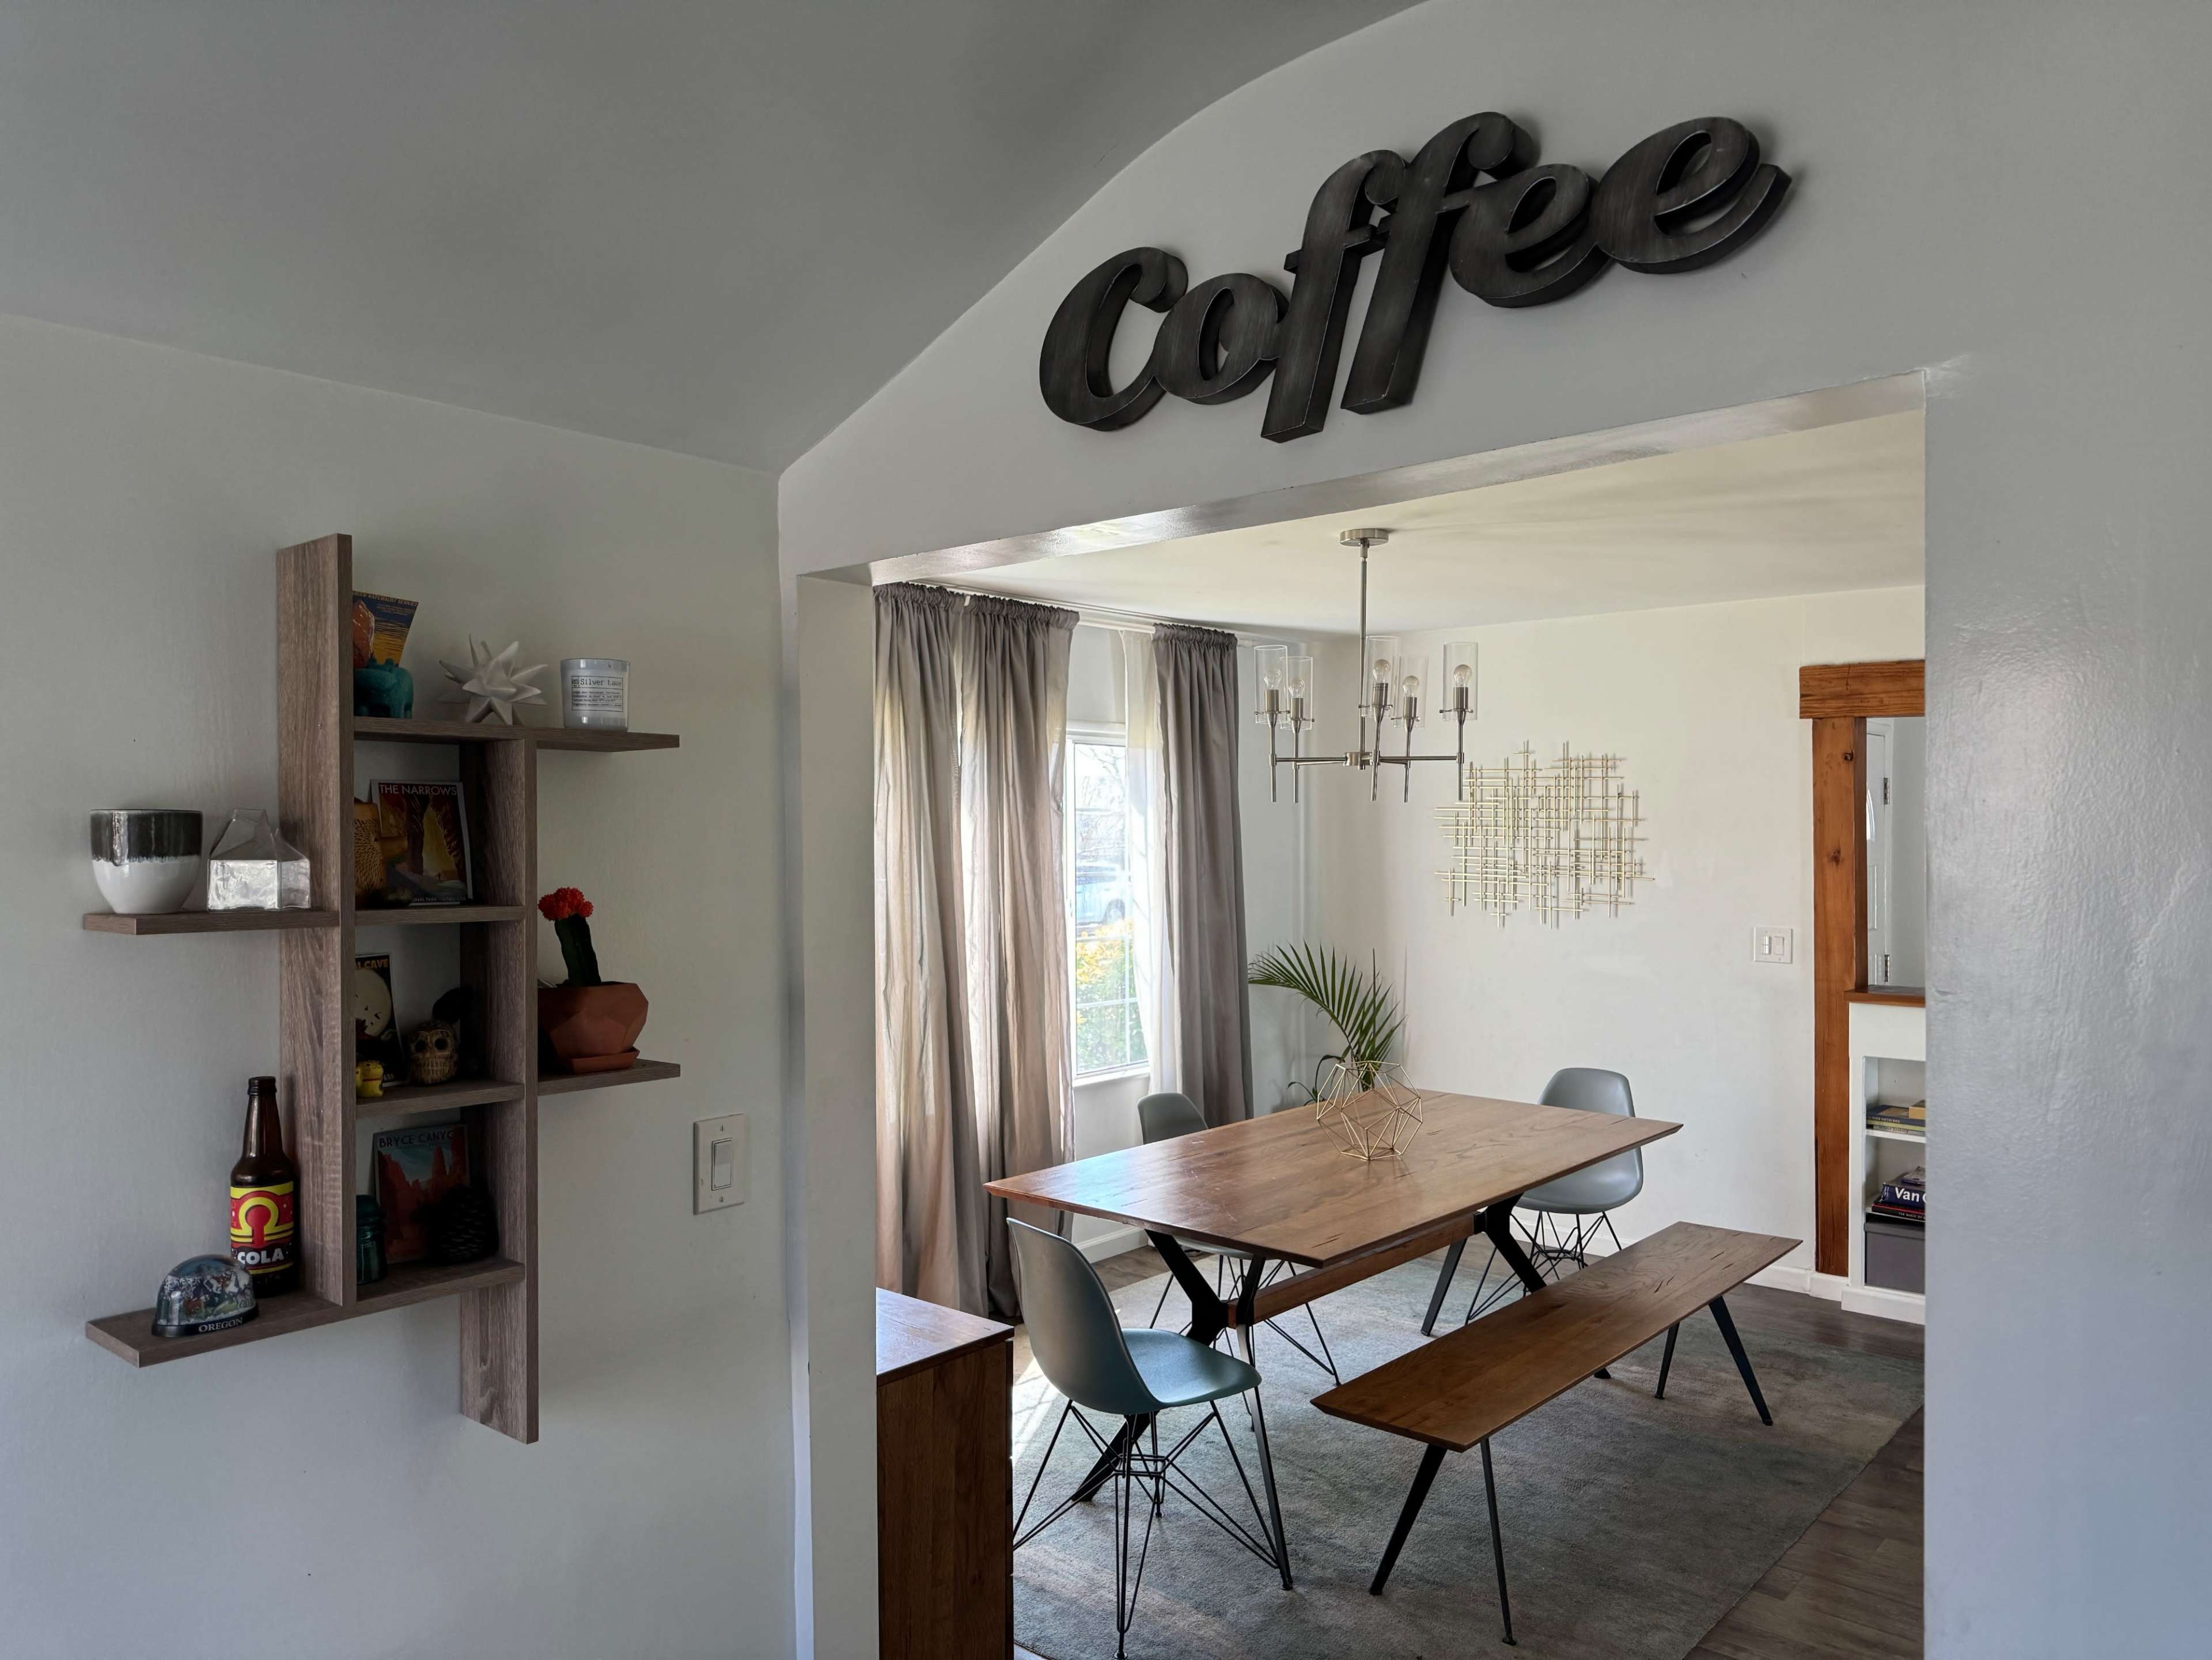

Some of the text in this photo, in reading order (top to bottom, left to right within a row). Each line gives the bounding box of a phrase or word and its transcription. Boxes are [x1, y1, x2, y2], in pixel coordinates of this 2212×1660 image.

[1039, 111, 1792, 443] coffee
[379, 784, 457, 795] THE NARROWS
[364, 959, 388, 969] CAVE
[379, 1135, 415, 1148] BRYCE
[418, 1129, 457, 1143] CANYO
[1895, 1187, 1920, 1203] Van
[237, 1247, 285, 1265] COLA
[198, 1317, 244, 1332] OREGON
